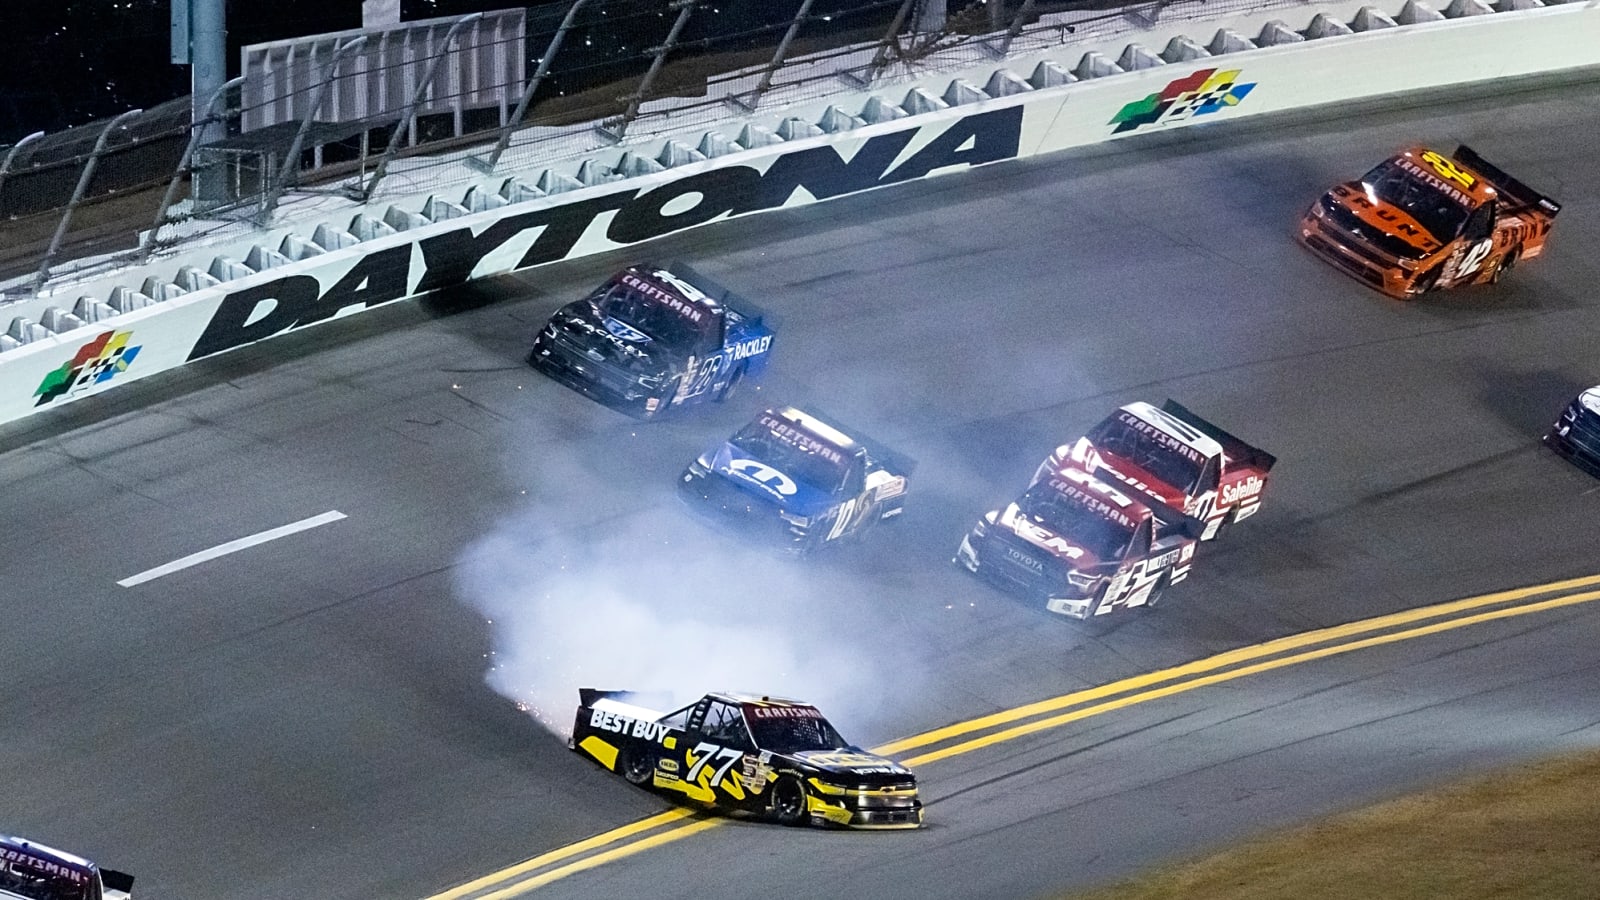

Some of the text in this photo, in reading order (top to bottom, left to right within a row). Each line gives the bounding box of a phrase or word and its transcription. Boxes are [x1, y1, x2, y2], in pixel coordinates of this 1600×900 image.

[1394, 158, 1470, 208] CRAFTSMAN
[187, 105, 1024, 361] DAYTONA
[1334, 185, 1440, 249] BRUNT
[1455, 239, 1493, 279] 42
[622, 274, 702, 323] CRAFTSMAN
[734, 335, 773, 361] RACKLEY
[760, 416, 842, 464] CRAFTSMAN
[1119, 413, 1200, 462] CRAFTSMAN
[1049, 479, 1129, 527] CRAFTSMAN
[1221, 476, 1263, 504] Safelite
[826, 499, 856, 541] 10
[1008, 548, 1044, 570] TOYOTA
[590, 709, 672, 744] BEST BUY
[755, 707, 822, 719] CRAFTSMAN
[686, 742, 744, 787] 77
